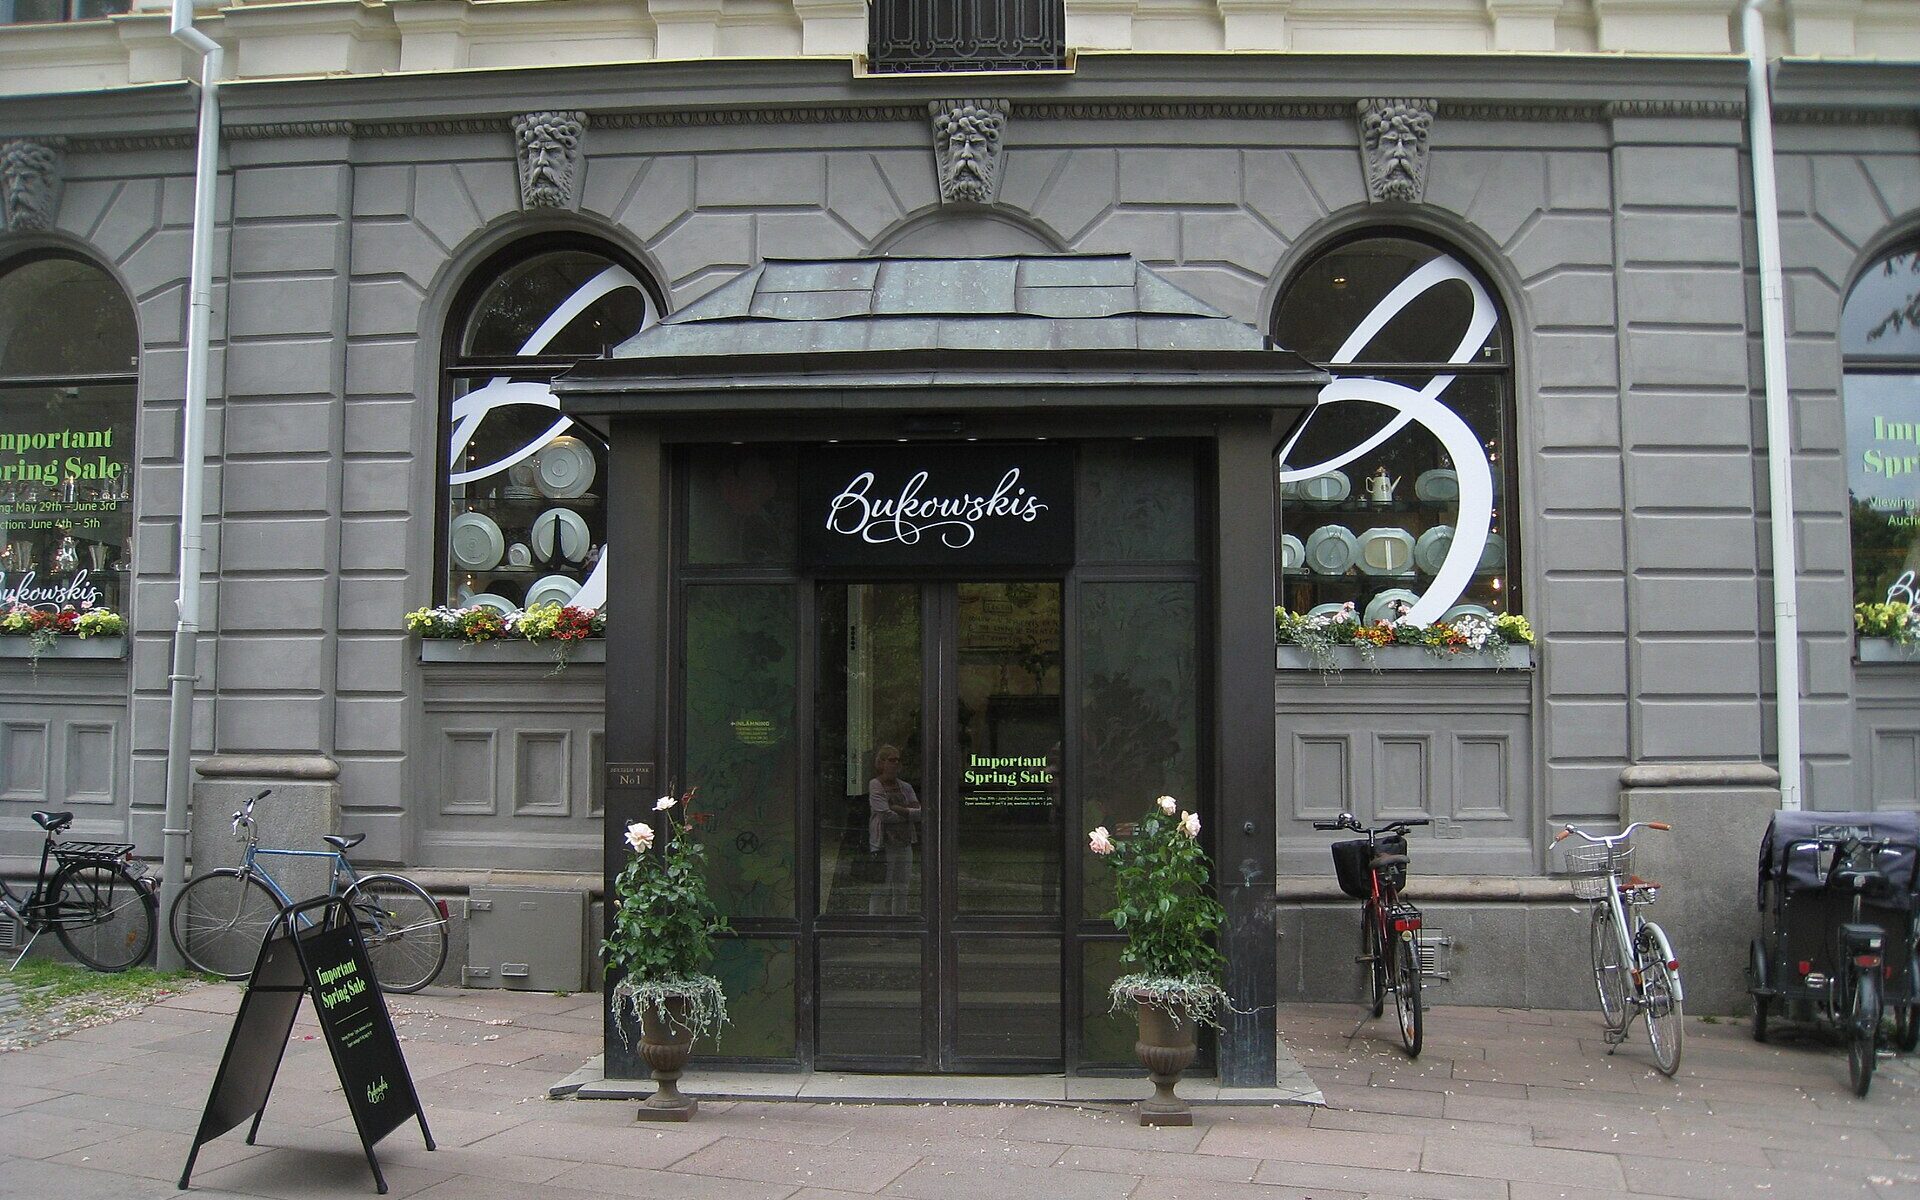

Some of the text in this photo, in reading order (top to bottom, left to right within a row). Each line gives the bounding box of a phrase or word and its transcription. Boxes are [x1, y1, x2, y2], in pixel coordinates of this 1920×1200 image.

[0, 427, 113, 454] mportant
[0, 456, 121, 487] ring Sale
[1863, 449, 1920, 479] Spr
[16, 502, 37, 513] May
[40, 501, 62, 512] 29th
[73, 501, 97, 511] June
[100, 500, 117, 511] 3rd
[826, 467, 1049, 549] Bukowskis
[0, 520, 26, 530] ction:
[28, 520, 52, 530] June
[83, 518, 101, 528] 5th
[0, 568, 104, 614] ukowskis
[970, 753, 1047, 770] Important
[964, 770, 1054, 787] Spring Sale
[316, 957, 357, 986] Important
[321, 976, 367, 1009] Spring Sale
